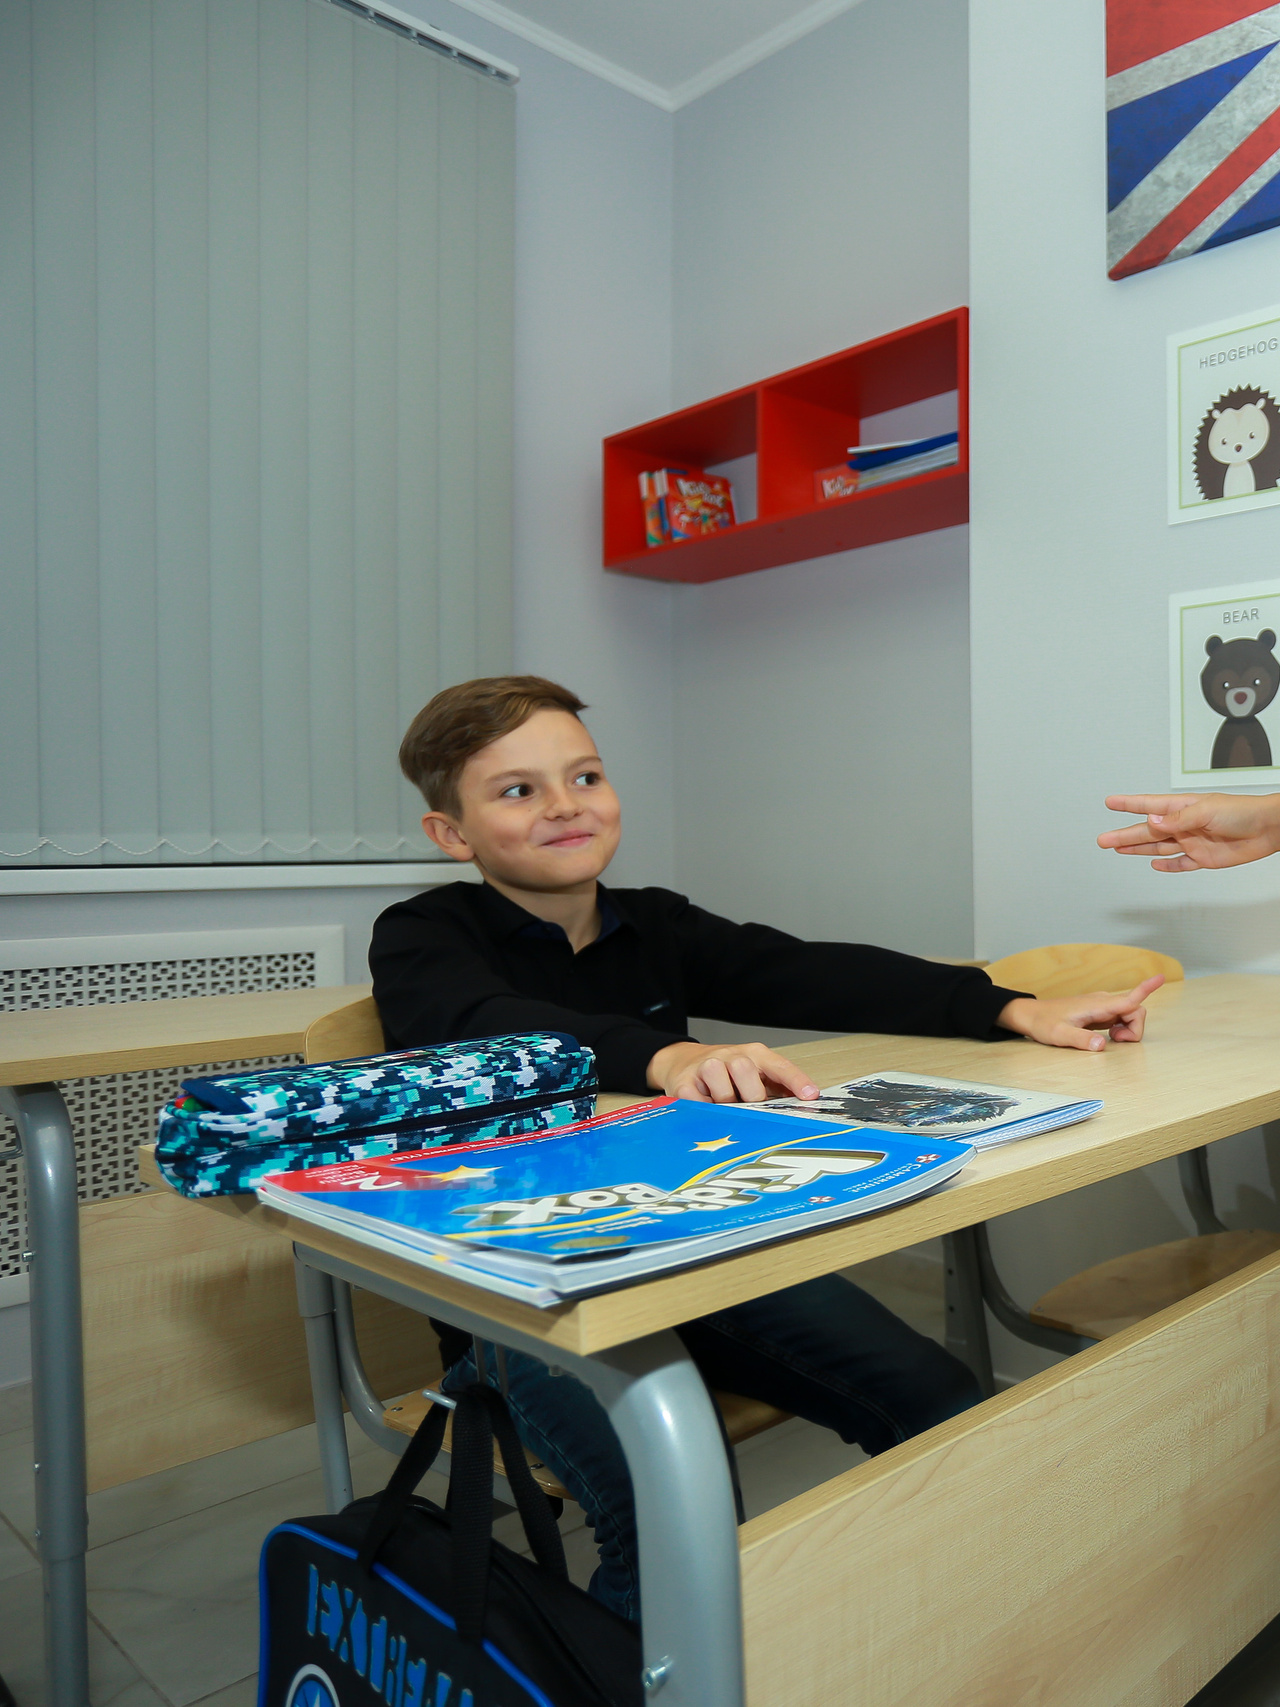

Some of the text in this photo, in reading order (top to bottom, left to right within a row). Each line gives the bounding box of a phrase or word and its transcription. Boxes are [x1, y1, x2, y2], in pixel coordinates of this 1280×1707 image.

[1198, 336, 1280, 370] HEDGEHOG
[1222, 608, 1260, 625] BEAR
[340, 1174, 404, 1191] 2
[633, 1153, 882, 1215] Kid's
[848, 1163, 922, 1193] CAMBRIDGE
